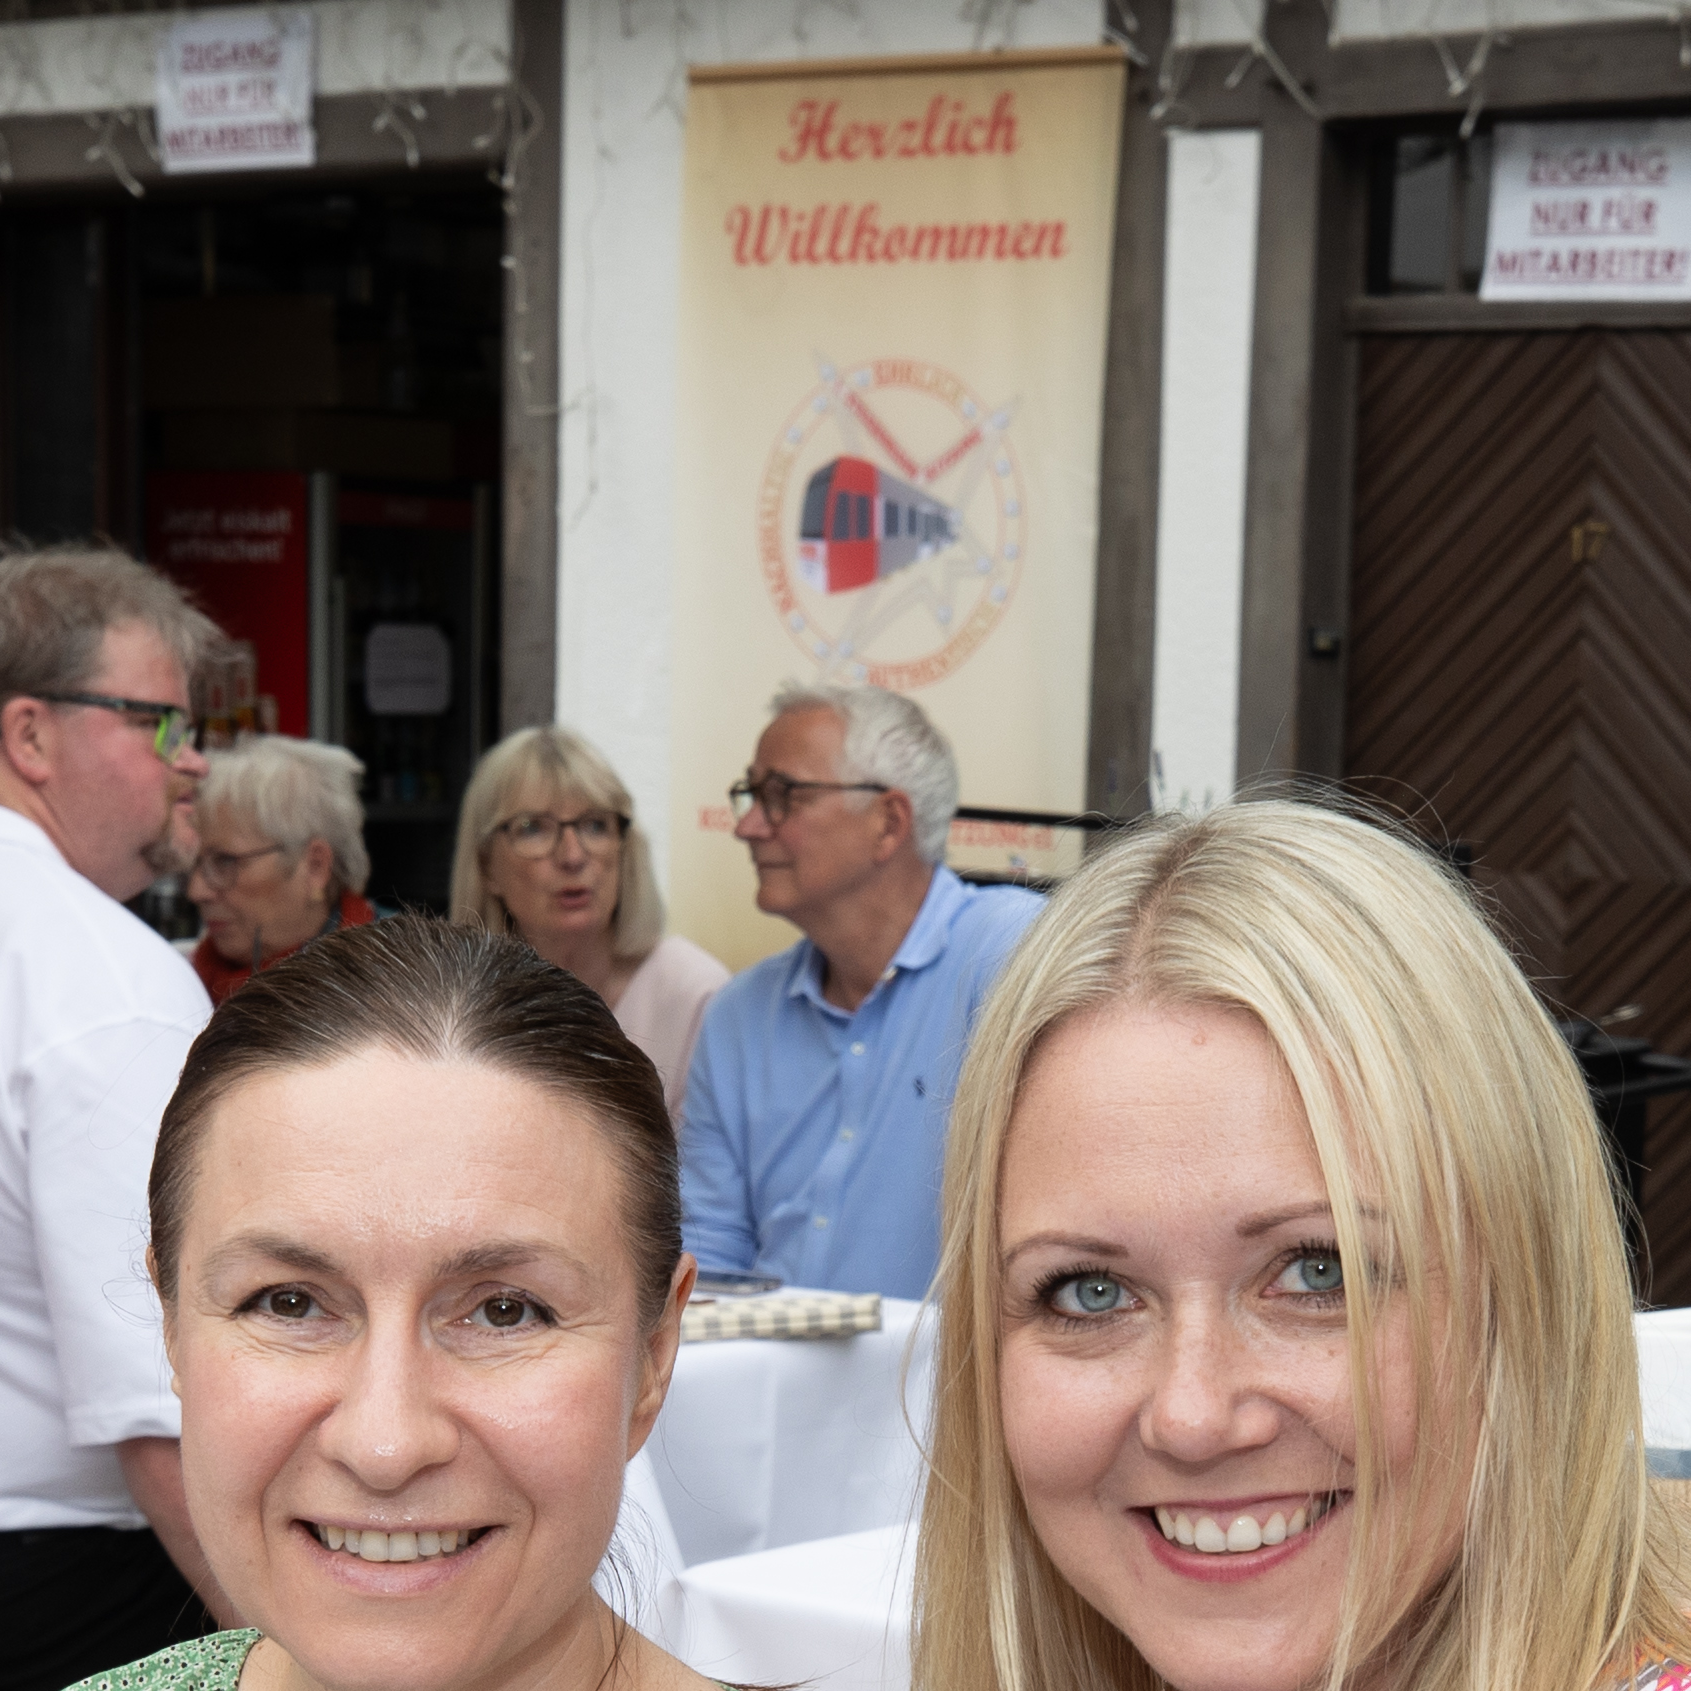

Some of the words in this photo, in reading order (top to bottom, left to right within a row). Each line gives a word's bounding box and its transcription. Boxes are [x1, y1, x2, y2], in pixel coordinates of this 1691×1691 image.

[778, 92, 1020, 165] Herzlich
[1528, 146, 1669, 184] ZUGANG
[1530, 200, 1590, 233] NUR
[1602, 192, 1658, 231] FÜR
[725, 203, 1070, 266] Willkommen
[1493, 247, 1690, 281] MITARBEITER!
[1568, 523, 1612, 564] 17
